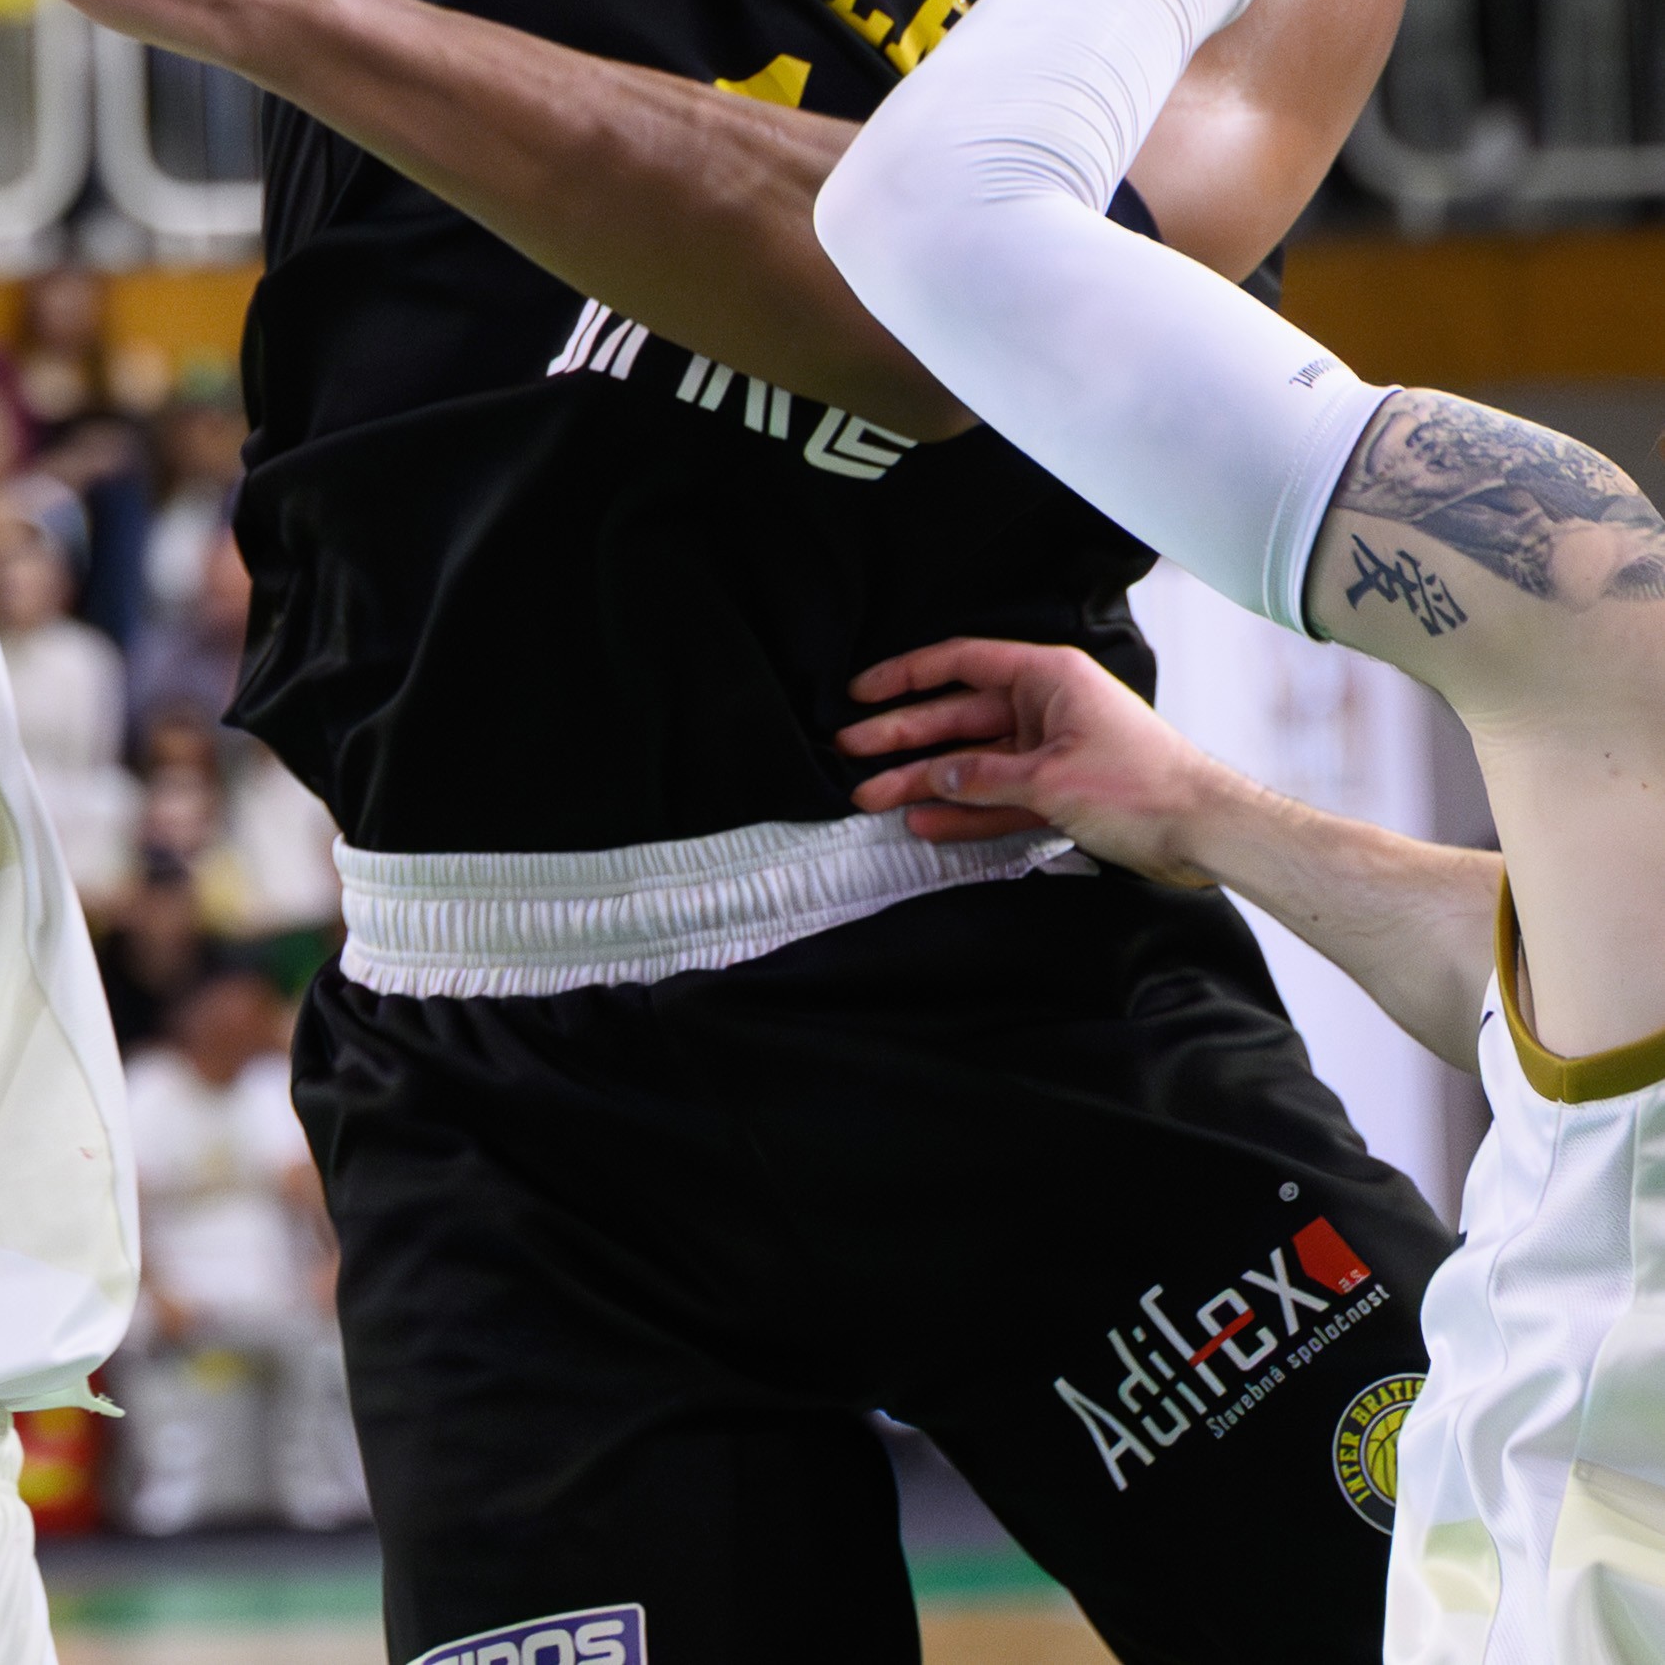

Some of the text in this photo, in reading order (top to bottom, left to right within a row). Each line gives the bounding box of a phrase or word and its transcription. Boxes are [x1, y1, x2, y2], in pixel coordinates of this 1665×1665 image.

[1205, 1365, 1286, 1440] Stavebná
[1339, 1379, 1425, 1503] INTER BRATI
